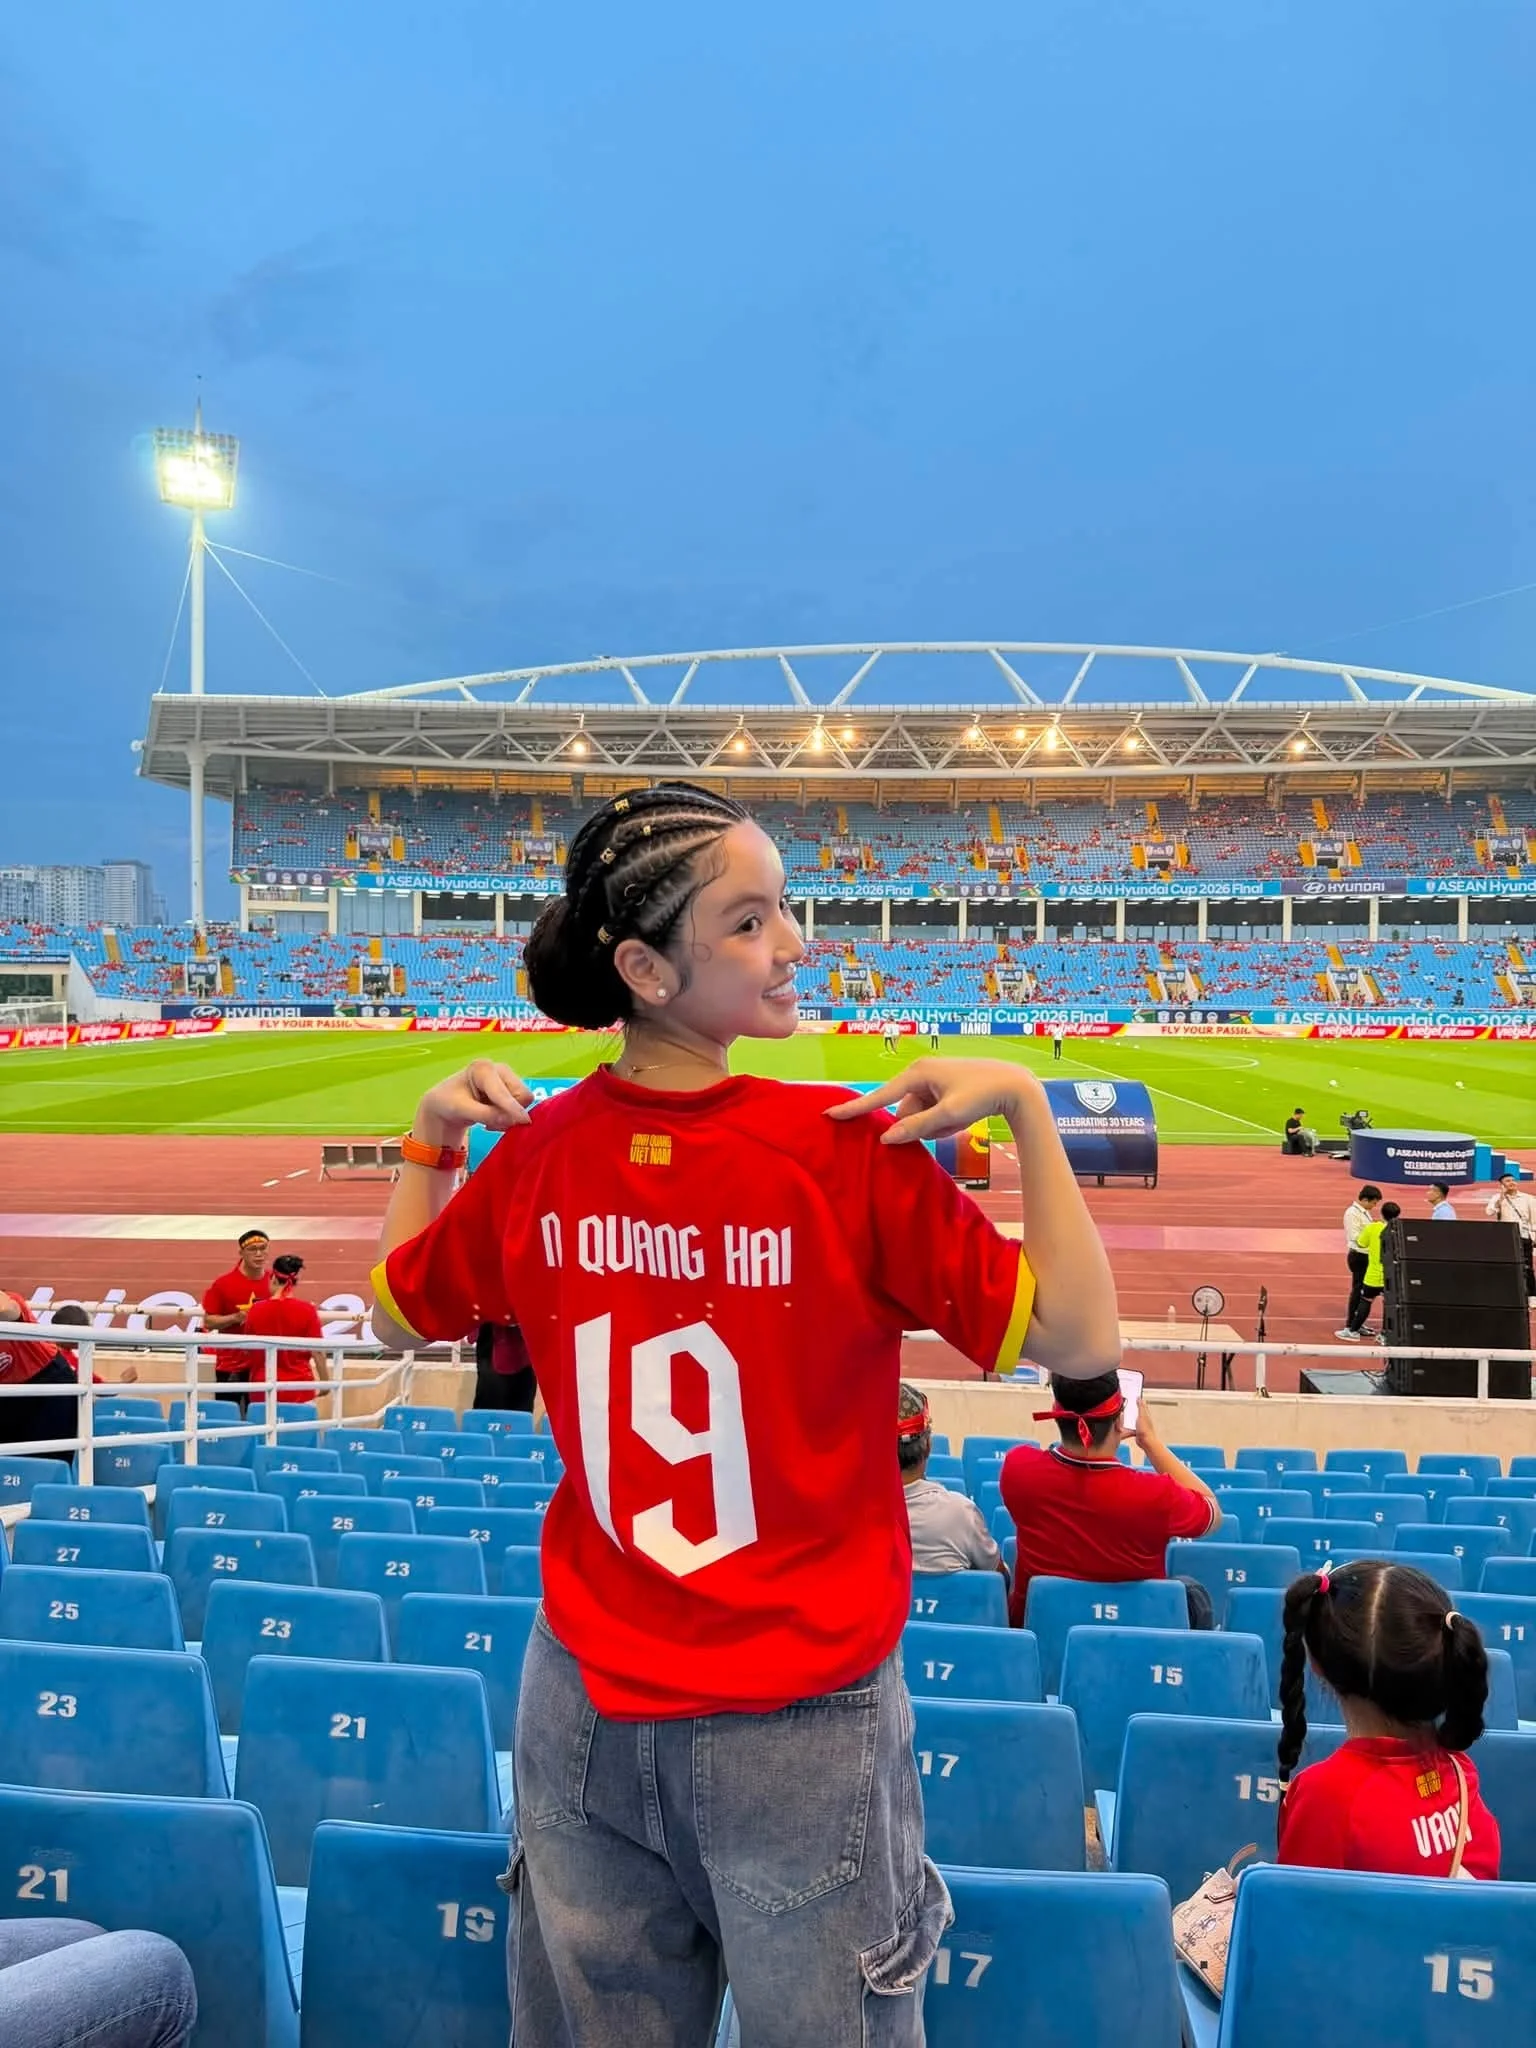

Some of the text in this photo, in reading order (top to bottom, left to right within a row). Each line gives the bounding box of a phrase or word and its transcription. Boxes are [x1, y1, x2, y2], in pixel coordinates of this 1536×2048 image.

[387, 876, 433, 887] ASEAN
[435, 878, 489, 890] Hyundai
[493, 880, 518, 891] Cup
[520, 881, 549, 891] 2026
[784, 884, 913, 897] yundai Cup 2026 Final
[1069, 883, 1263, 896] ASEAN Hyundai Cup 2026 Final
[1328, 882, 1385, 893] HYUNDAI
[1437, 881, 1536, 893] ASEAN Hyund
[225, 1007, 300, 1018] HYUNDAI
[454, 1006, 512, 1018] ASEAN
[870, 1009, 922, 1021] ASEAN
[995, 1010, 1028, 1022] Cup
[1030, 1010, 1068, 1022] 2026
[1071, 1011, 1108, 1023] Final
[1291, 1012, 1352, 1025] ASEAN
[1356, 1013, 1433, 1026] Hyundai
[1436, 1014, 1475, 1026] Cup
[282, 1020, 313, 1029] YOUR
[961, 1023, 991, 1035] HANOI
[1161, 1026, 1184, 1035] FLY
[1184, 1026, 1216, 1035] YOUR
[1057, 1117, 1108, 1127] CELEBRATING
[1120, 1118, 1145, 1127] YEARS
[578, 1215, 705, 1281] QUANG
[724, 1225, 791, 1288] HAI
[574, 1311, 758, 1578] 19
[441, 1448, 455, 1457] 27
[3, 1475, 20, 1486] 28
[482, 1474, 499, 1485] 25
[416, 1496, 434, 1507] 25
[1427, 1490, 1436, 1499] 7
[69, 1508, 91, 1521] 29
[206, 1512, 226, 1525] 27
[1257, 1506, 1273, 1517] 11
[332, 1517, 354, 1530] 25
[1497, 1515, 1507, 1526] 7
[470, 1529, 491, 1542] 23
[1313, 1539, 1331, 1551] 11
[57, 1548, 81, 1562] 27
[213, 1555, 239, 1572] 25
[385, 1561, 411, 1577] 23
[1225, 1568, 1247, 1583] 13
[49, 1601, 80, 1621] 25
[914, 1599, 939, 1614] 17
[1092, 1603, 1119, 1620] 15
[261, 1618, 292, 1639] 23
[1501, 1625, 1525, 1641] 11
[464, 1632, 493, 1653] 21
[923, 1661, 955, 1681] 17
[1151, 1664, 1184, 1687] 15
[38, 1691, 78, 1718] 23
[329, 1713, 367, 1740] 21
[918, 1751, 960, 1778] 17
[1234, 1774, 1280, 1804] 15
[16, 1864, 69, 1904] 21
[437, 1902, 497, 1943] 19
[934, 1948, 993, 1989] 17
[1423, 1954, 1494, 2001] 15
